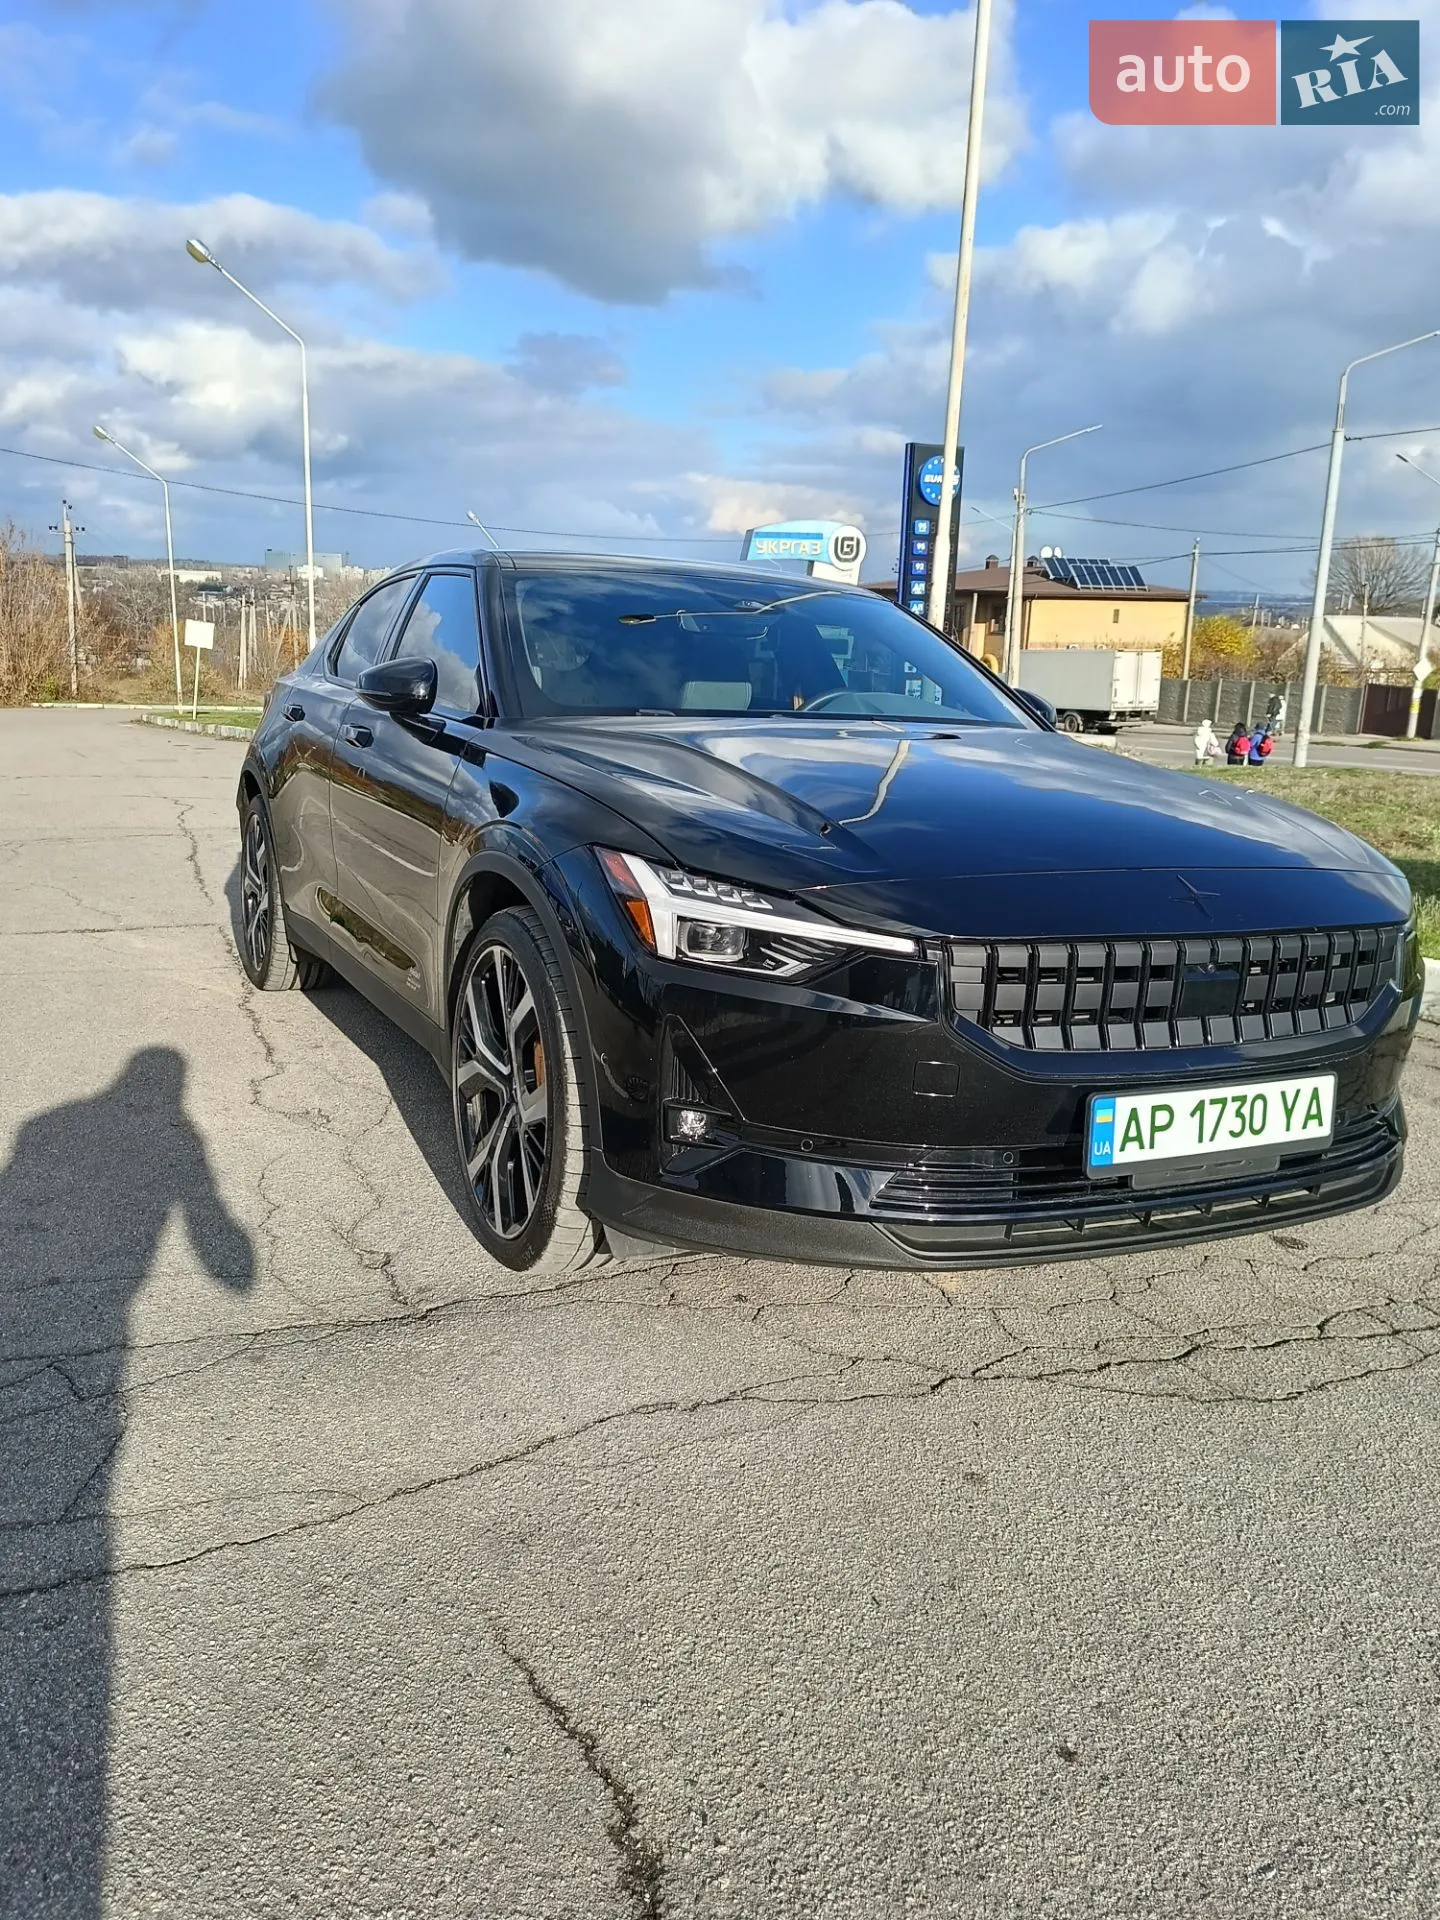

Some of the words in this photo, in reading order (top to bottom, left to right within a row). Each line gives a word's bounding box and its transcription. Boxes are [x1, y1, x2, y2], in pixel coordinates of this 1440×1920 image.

[755, 539, 822, 555] УКРГАЗ
[1119, 1103, 1175, 1152] AP
[1189, 1092, 1268, 1144] 1730
[1280, 1087, 1323, 1132] YA
[1094, 1141, 1112, 1156] UA
